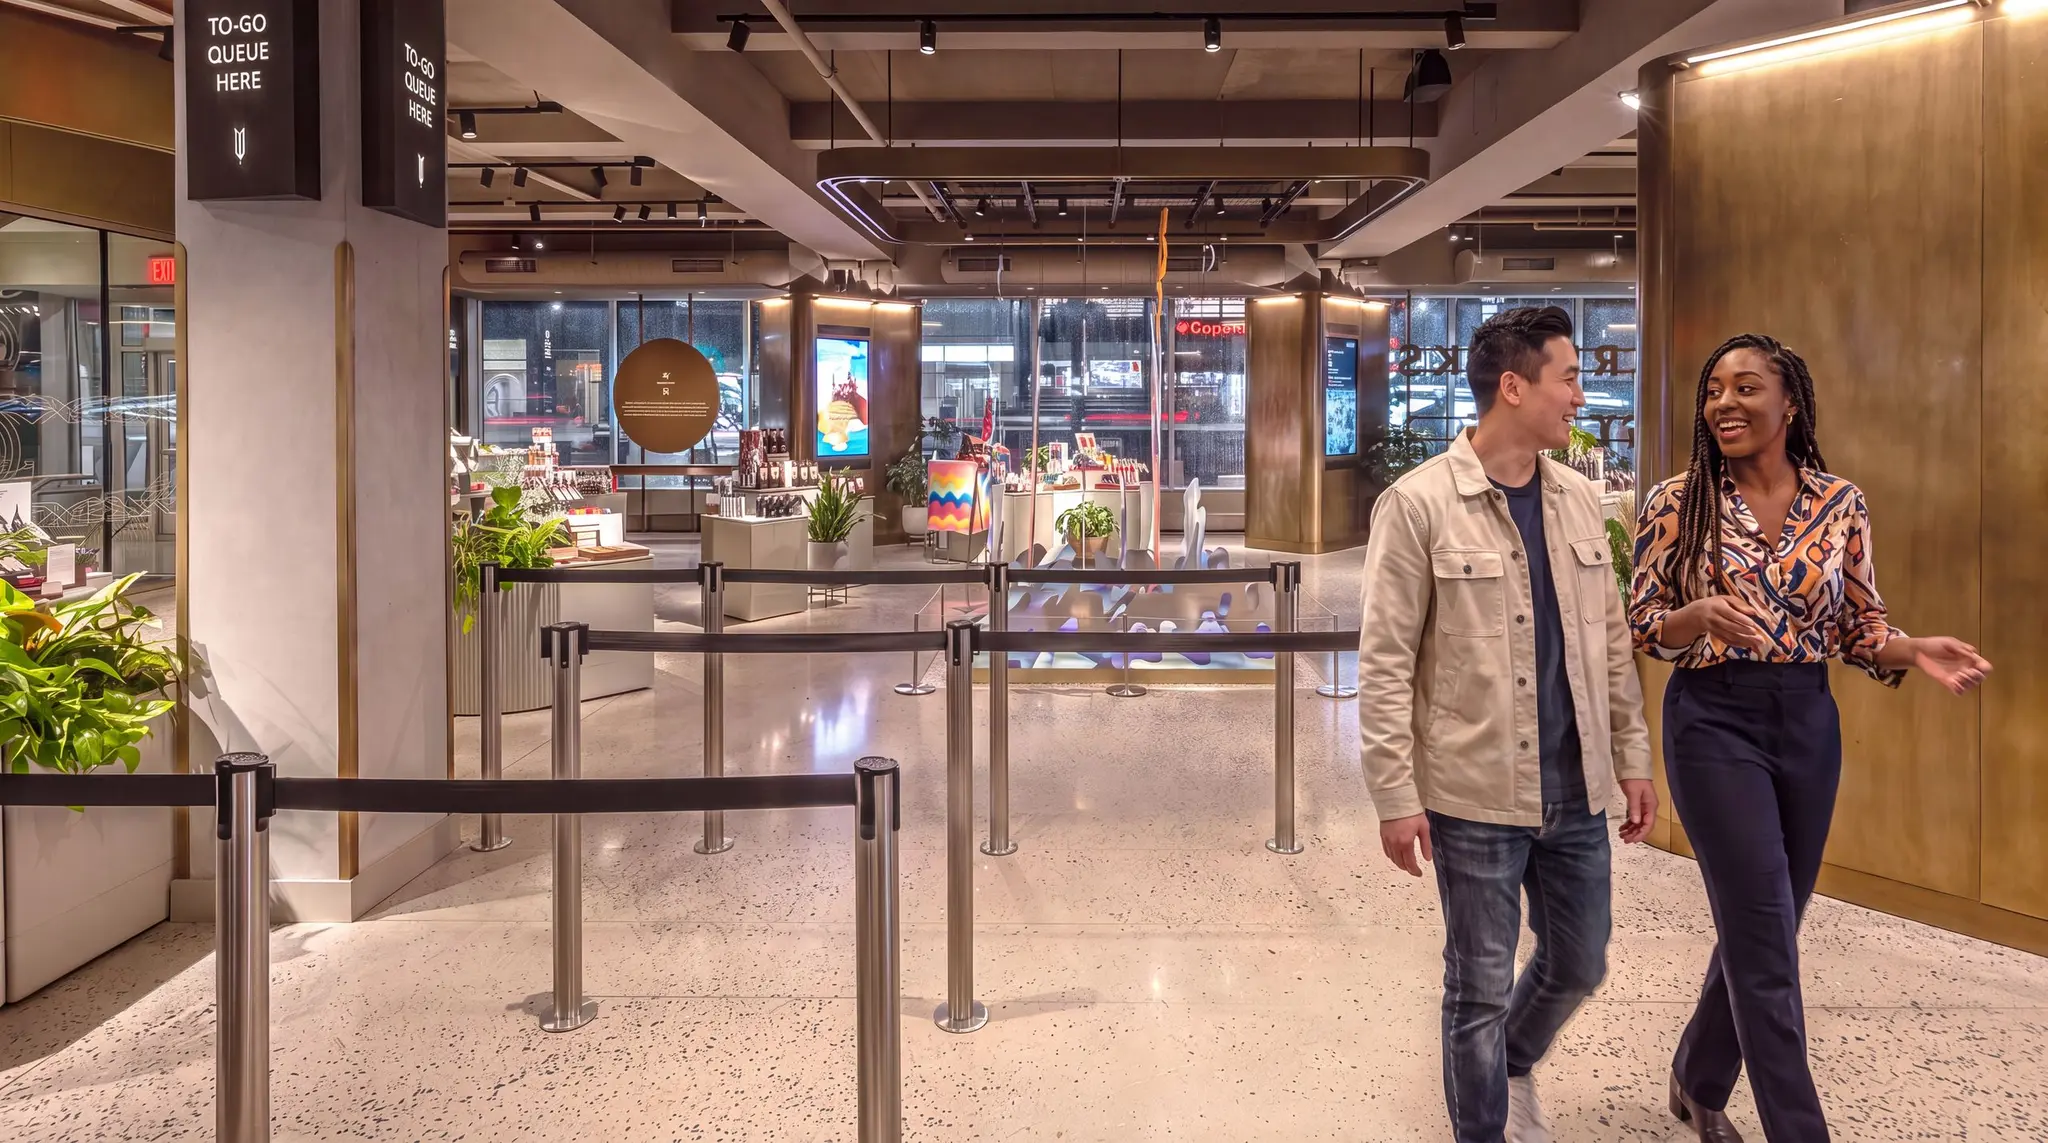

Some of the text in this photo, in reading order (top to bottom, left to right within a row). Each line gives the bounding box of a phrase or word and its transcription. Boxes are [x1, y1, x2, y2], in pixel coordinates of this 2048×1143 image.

[208, 13, 267, 36] TO-GO
[207, 41, 269, 65] QUEUE
[404, 42, 435, 80] TO-GO
[216, 71, 262, 92] HERE
[404, 71, 436, 106] QUEUE
[409, 98, 433, 128] HERE
